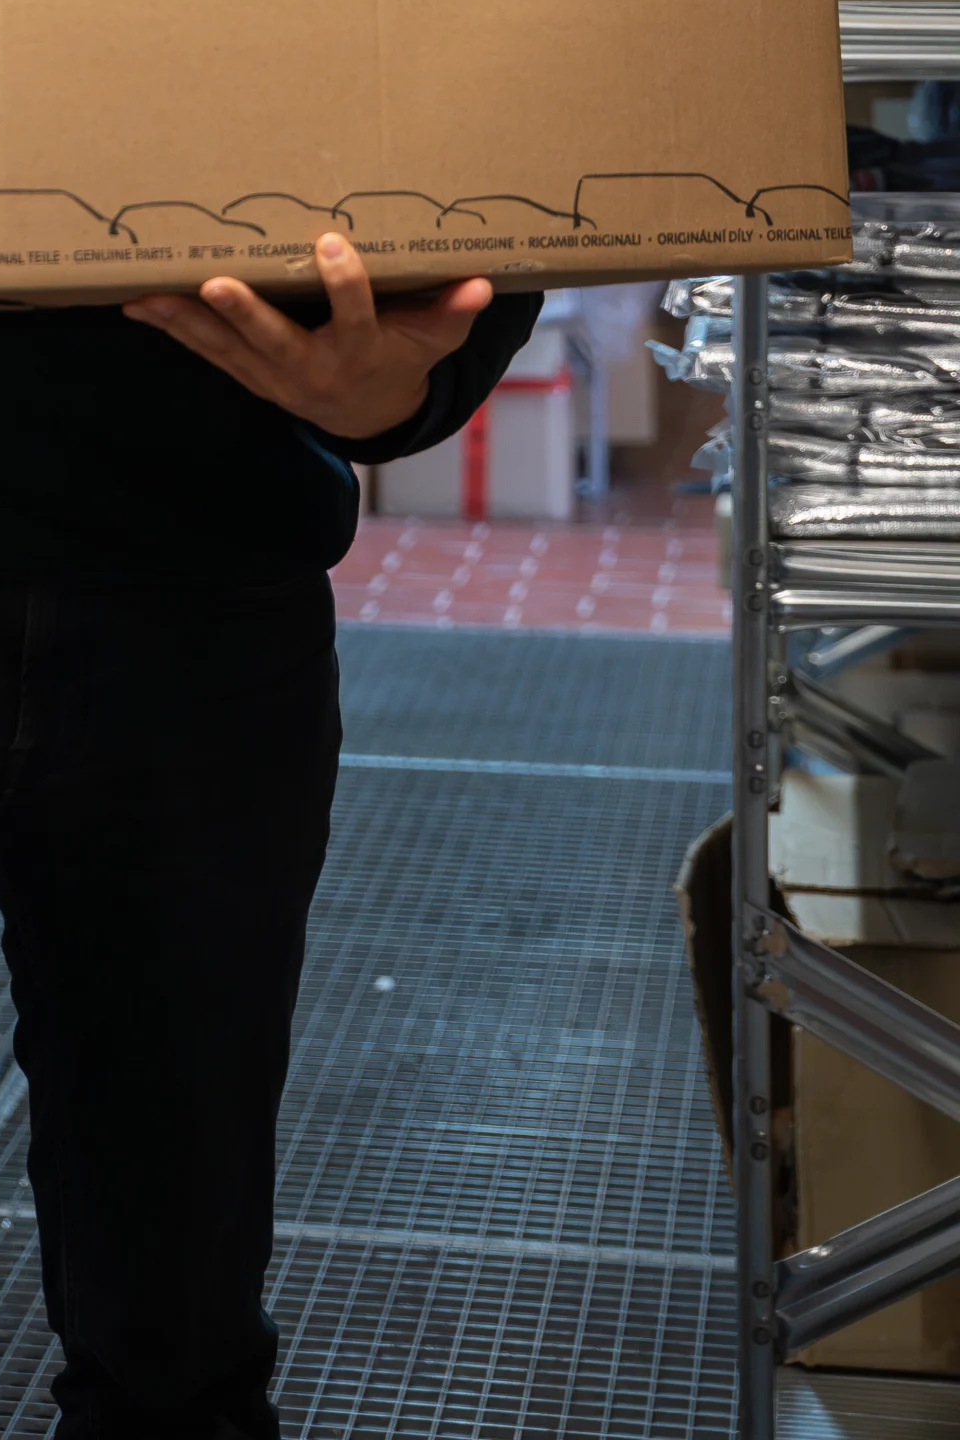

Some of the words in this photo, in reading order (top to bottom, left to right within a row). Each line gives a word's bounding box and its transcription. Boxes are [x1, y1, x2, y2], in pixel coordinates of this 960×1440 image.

[28, 250, 60, 265] TEILE
[73, 248, 132, 264] GENUINE
[135, 246, 172, 261] PARTS
[248, 242, 316, 258] RECAMBIO
[408, 236, 450, 252] PIÈCES
[452, 236, 515, 251] D'ORIGINE
[528, 234, 578, 250] RICAMBI
[581, 233, 641, 248] ORIGINALI
[656, 228, 727, 245] ORIGINÁLNÍ
[729, 227, 754, 243] DÍLY
[766, 228, 822, 243] ORIGINAL
[823, 226, 852, 240] TEILE
